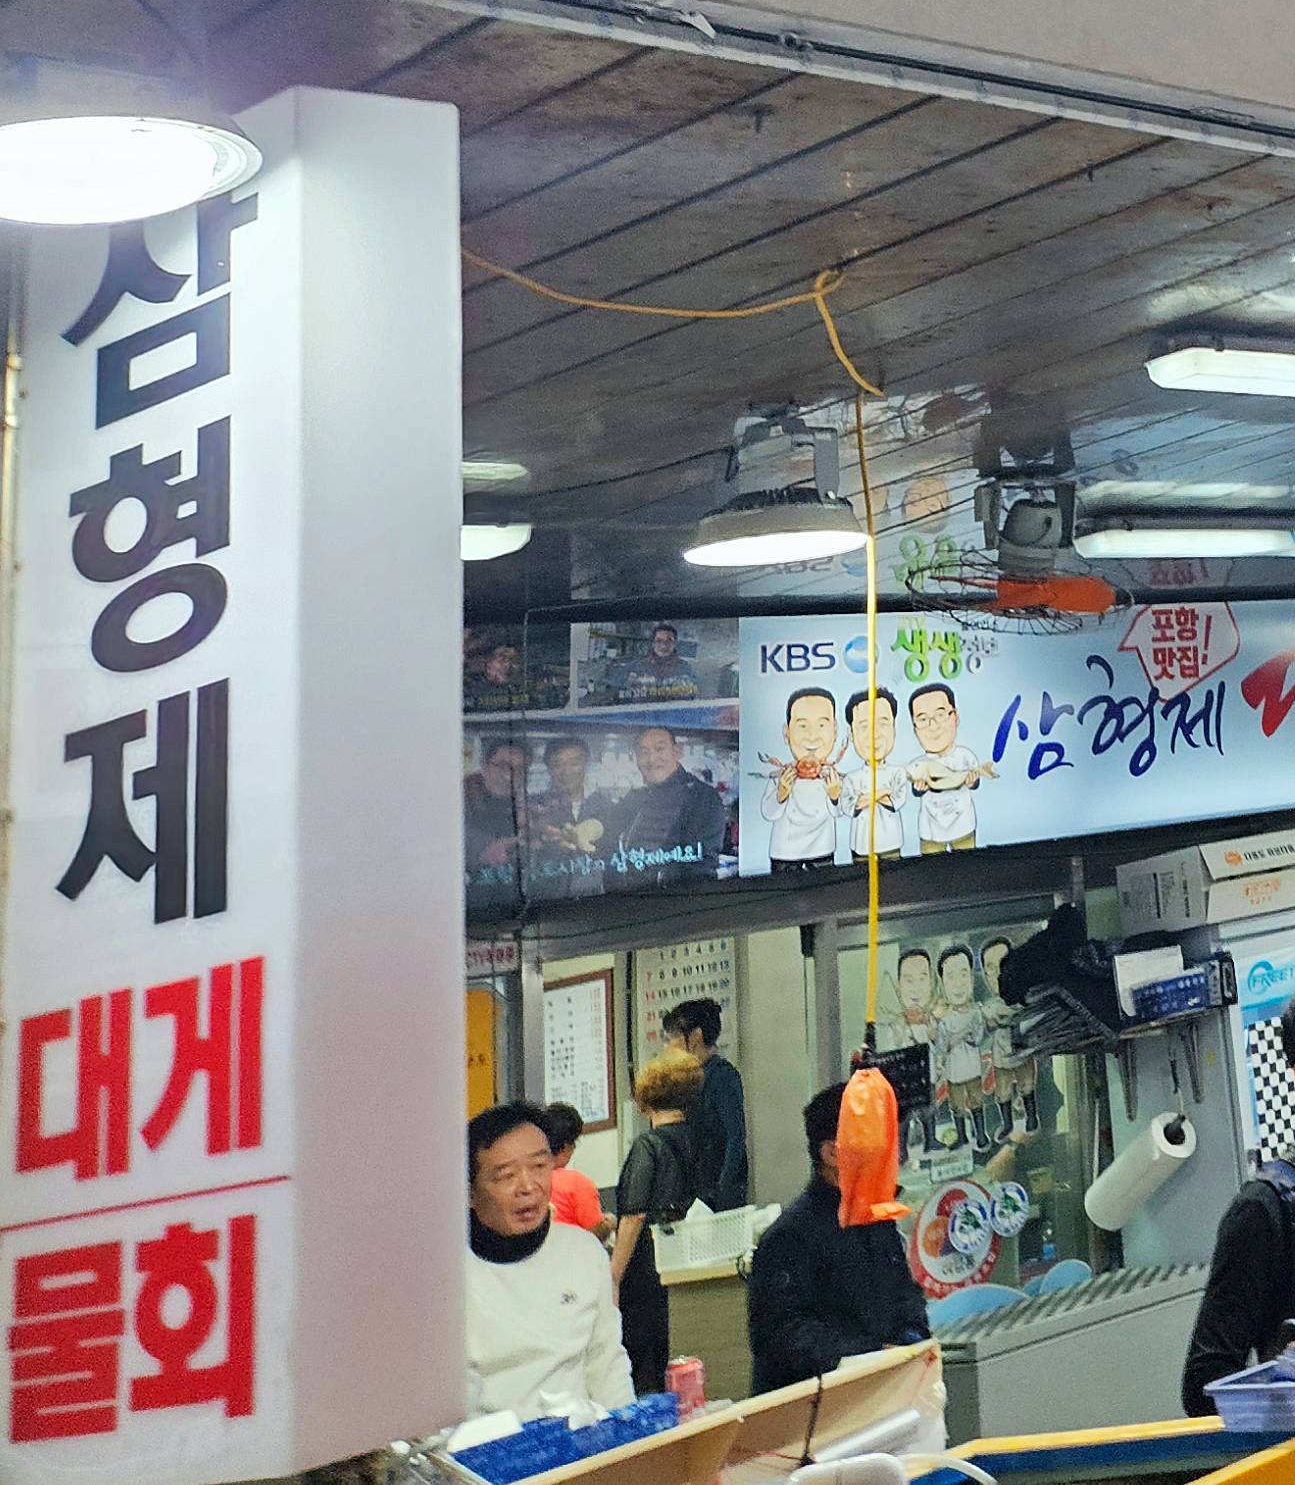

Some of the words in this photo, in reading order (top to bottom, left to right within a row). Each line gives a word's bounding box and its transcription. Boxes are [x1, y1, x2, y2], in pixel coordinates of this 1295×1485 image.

[55, 191, 259, 925] 삼형제
[1151, 606, 1200, 642] 포항
[760, 642, 836, 674] KBS
[992, 654, 1226, 779] 삼형제
[15, 955, 265, 1183] 대게
[8, 1214, 257, 1445] 물회
